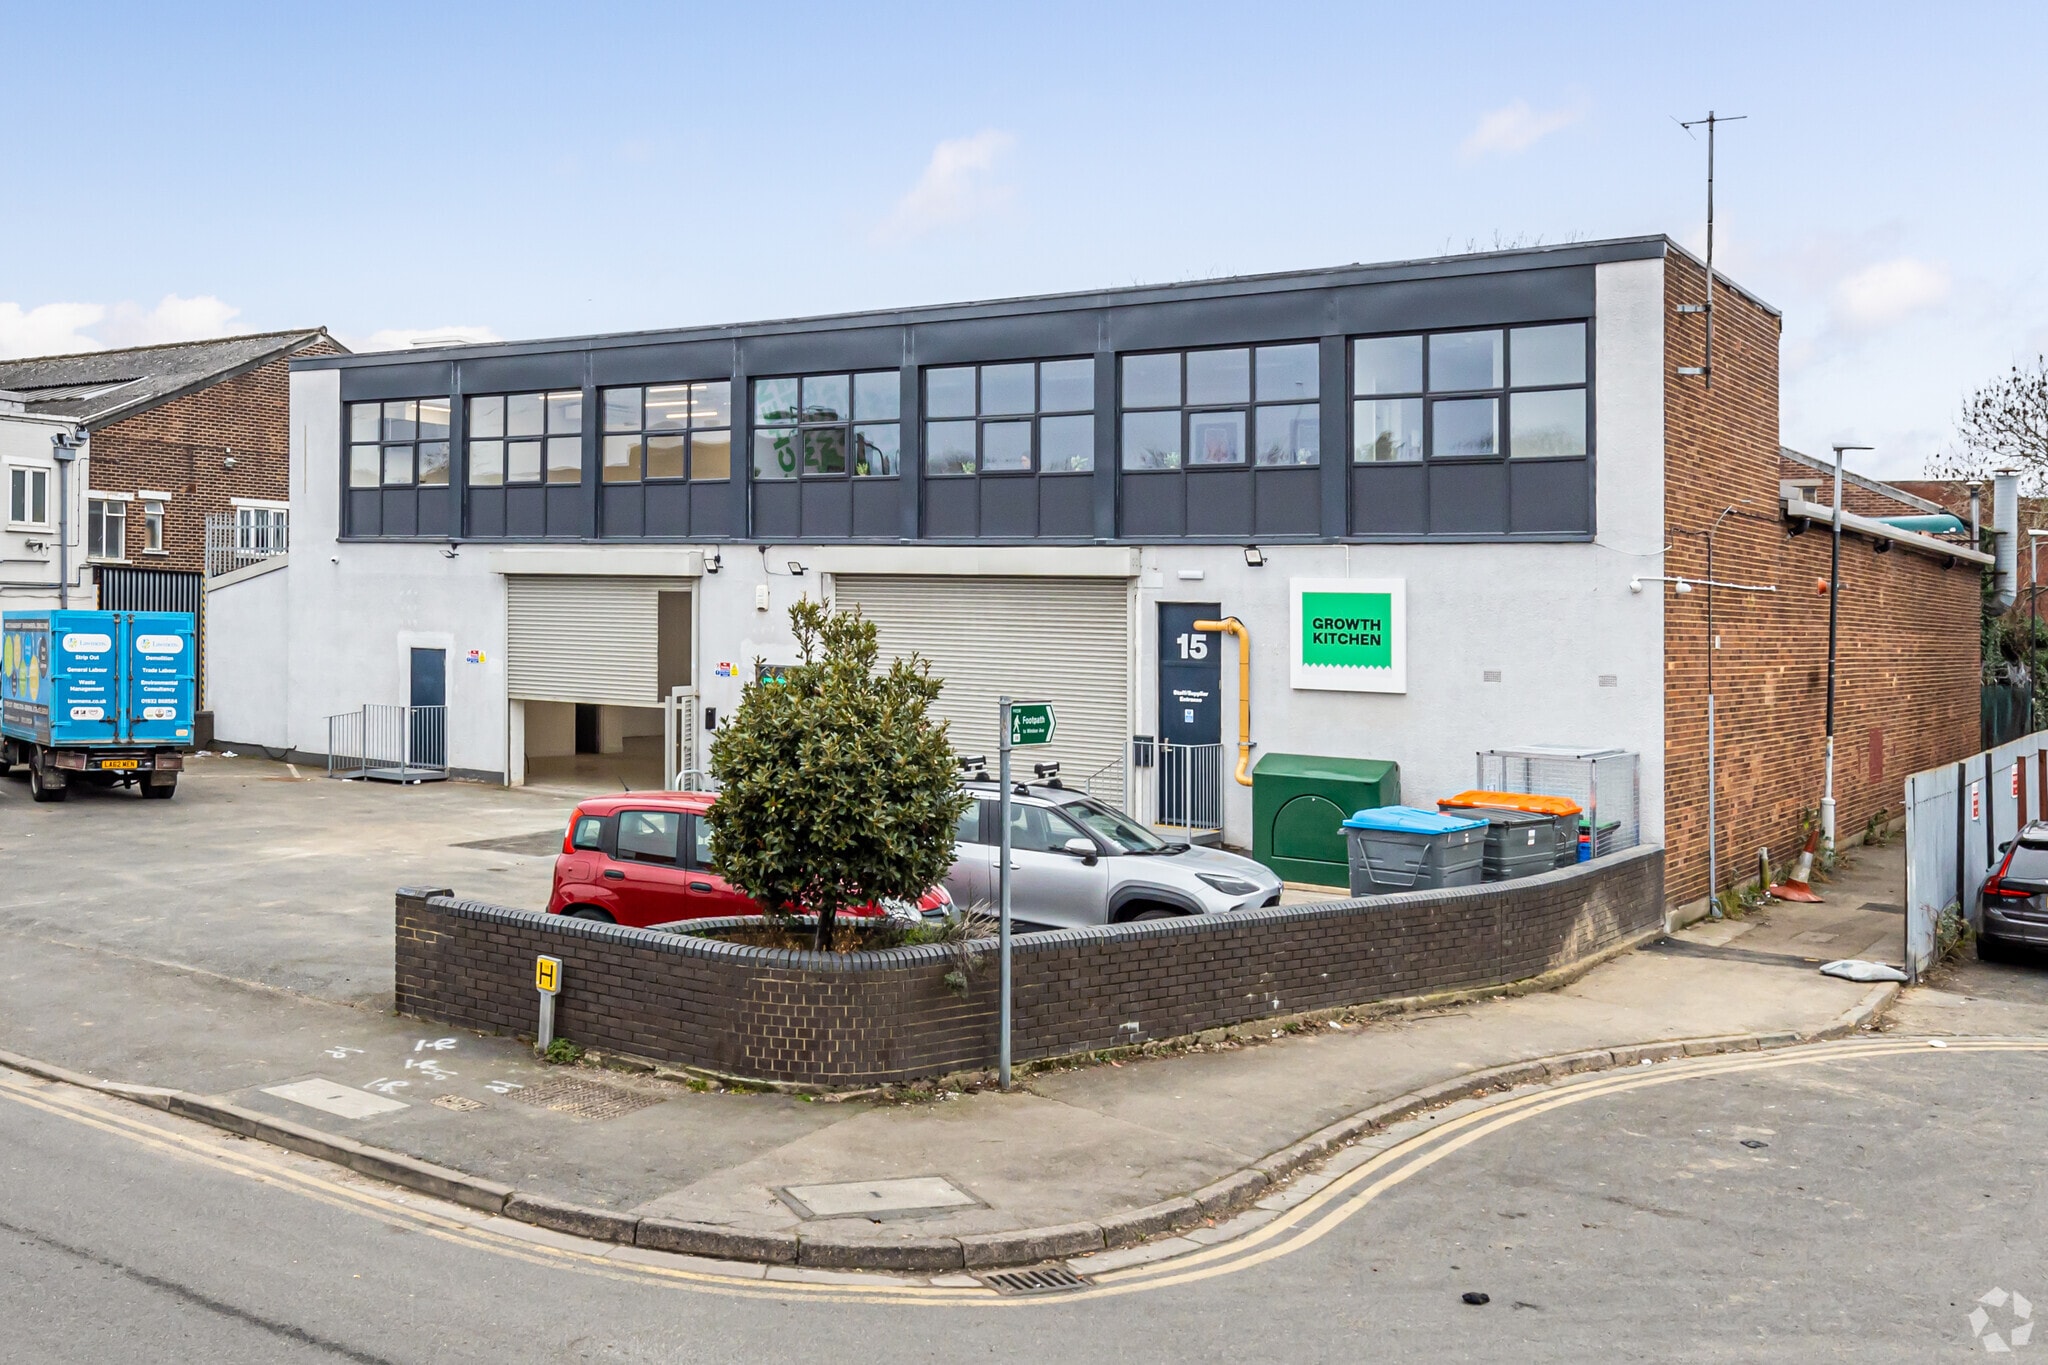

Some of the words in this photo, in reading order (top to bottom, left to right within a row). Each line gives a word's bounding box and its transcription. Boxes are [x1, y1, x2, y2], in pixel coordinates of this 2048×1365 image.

[1313, 618, 1381, 631] GROWTH
[1313, 632, 1381, 646] KITCHEN
[1177, 634, 1208, 660] 15
[1022, 716, 1045, 725] Footpath
[539, 962, 554, 988] H
